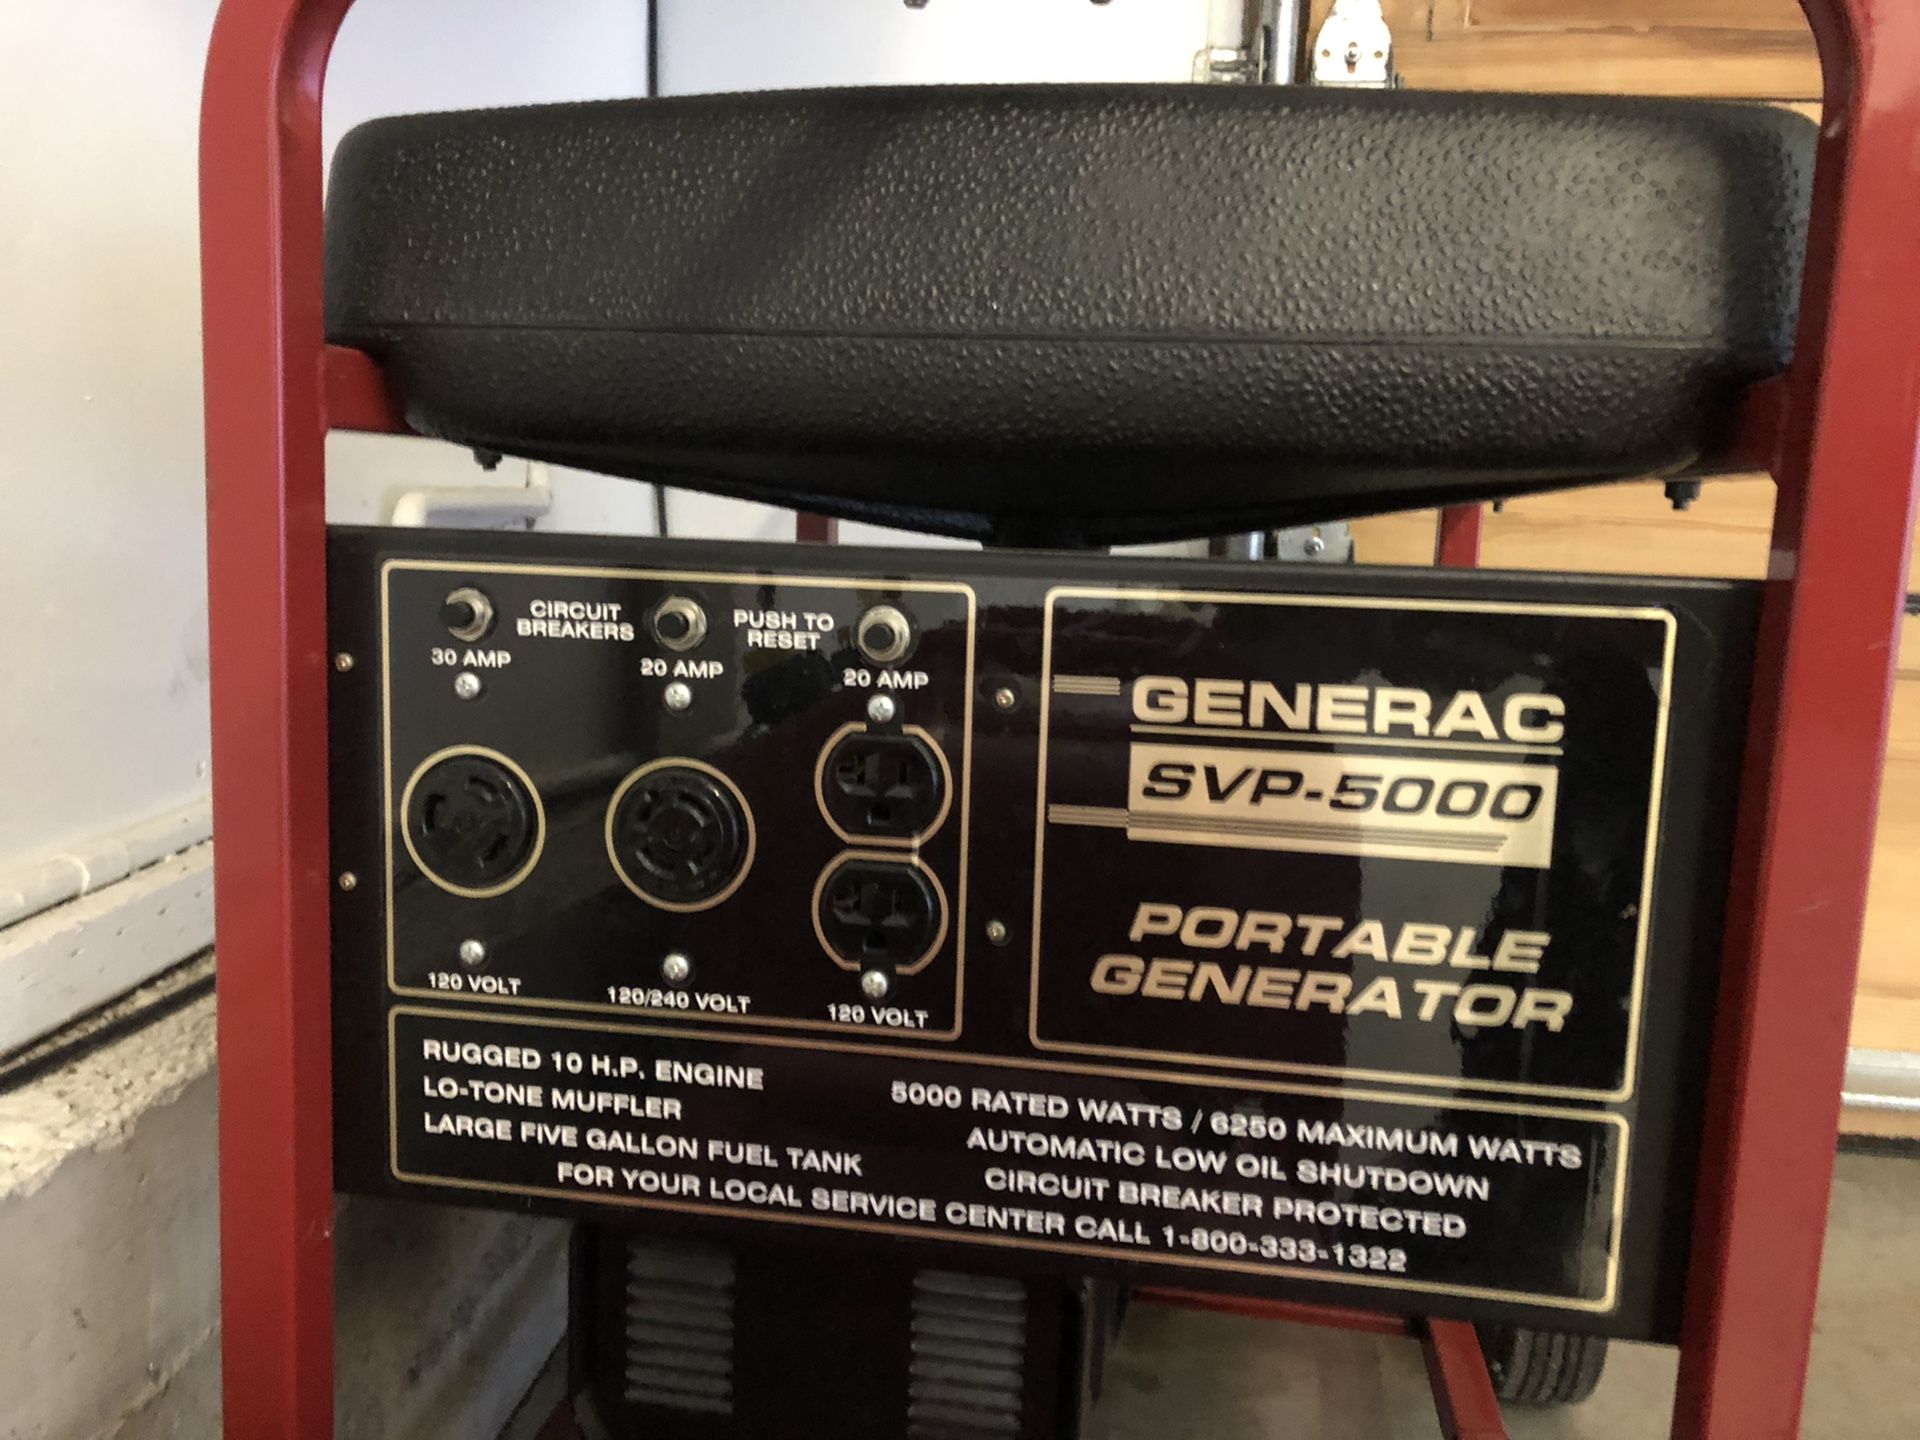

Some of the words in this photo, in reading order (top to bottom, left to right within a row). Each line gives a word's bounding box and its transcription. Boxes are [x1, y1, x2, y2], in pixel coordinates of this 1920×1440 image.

[517, 620, 634, 641] BREAKERS
[530, 600, 621, 621] CIRCUIT
[734, 611, 797, 631] PUSH
[804, 613, 834, 631] TO
[431, 648, 457, 665] 30
[463, 650, 511, 668] AMP
[747, 630, 820, 651] RESET
[641, 659, 667, 676] 20
[673, 660, 723, 679] AMP
[843, 669, 870, 687] 20
[877, 671, 929, 690] AMP
[1132, 676, 1566, 744] GENERAC
[1142, 763, 1544, 822] SVP-5000
[1129, 902, 1552, 973] PORTABLE
[428, 973, 462, 991] 120
[468, 975, 521, 994] VOLT
[607, 986, 688, 1009] 120/240
[696, 993, 750, 1014] VOLT
[1090, 954, 1574, 1032] GENERATOR
[827, 1004, 864, 1024] 120
[871, 1008, 928, 1028] VOLT
[423, 1040, 541, 1069] RUGGED
[552, 1052, 582, 1073] 10
[592, 1055, 645, 1081] H.P.
[655, 1061, 764, 1090] ENGINE
[423, 1076, 542, 1107] LO-TONE
[552, 1090, 682, 1119] MUFFLER
[424, 1112, 512, 1141] LARGE
[521, 1122, 577, 1147] FIVE
[586, 1131, 698, 1159] GALLON
[709, 1140, 778, 1167] FUEL
[786, 1148, 863, 1175] TANK
[891, 1082, 962, 1109] 5000
[971, 1089, 1069, 1119] RATED
[1078, 1098, 1182, 1132] WATTS
[1190, 1108, 1202, 1135] /
[1210, 1111, 1287, 1140] 6250
[1297, 1119, 1457, 1157] MAXIMUM
[1469, 1135, 1582, 1169] WATTS
[967, 1127, 1146, 1166] AUTOMATIC
[1156, 1147, 1227, 1173] LOW
[1236, 1154, 1287, 1181] OIL
[1297, 1161, 1489, 1200] SHUTDOWN
[558, 1162, 614, 1187] FOR
[622, 1168, 700, 1196] YOUR
[710, 1177, 802, 1207] LOCAL
[811, 1187, 936, 1222] SERVICE
[945, 1201, 1065, 1236] CENTER
[1074, 1215, 1151, 1246] CALL
[1162, 1225, 1407, 1272] 1-800-333-1322
[984, 1167, 1107, 1201] CIRCUIT
[1118, 1180, 1263, 1219] BREAKER
[1273, 1198, 1467, 1239] PROTECTED
